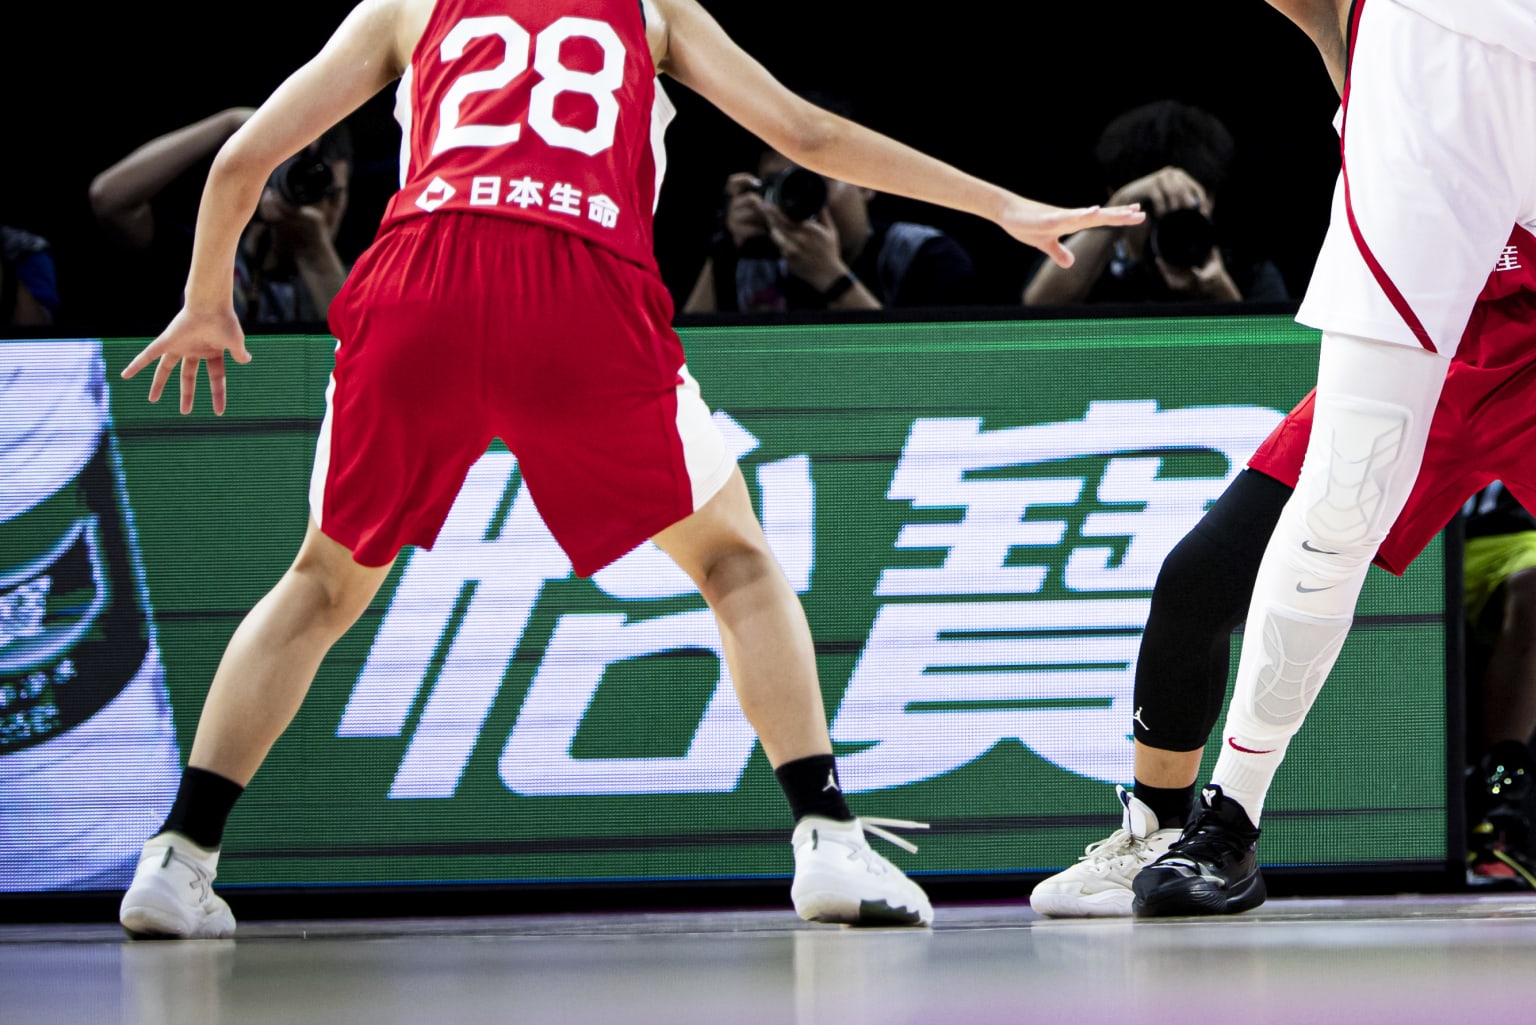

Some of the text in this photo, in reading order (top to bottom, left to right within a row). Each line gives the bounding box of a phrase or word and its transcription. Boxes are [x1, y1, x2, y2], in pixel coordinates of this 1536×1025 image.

[431, 15, 626, 157] 28
[469, 176, 620, 229] 日本生命
